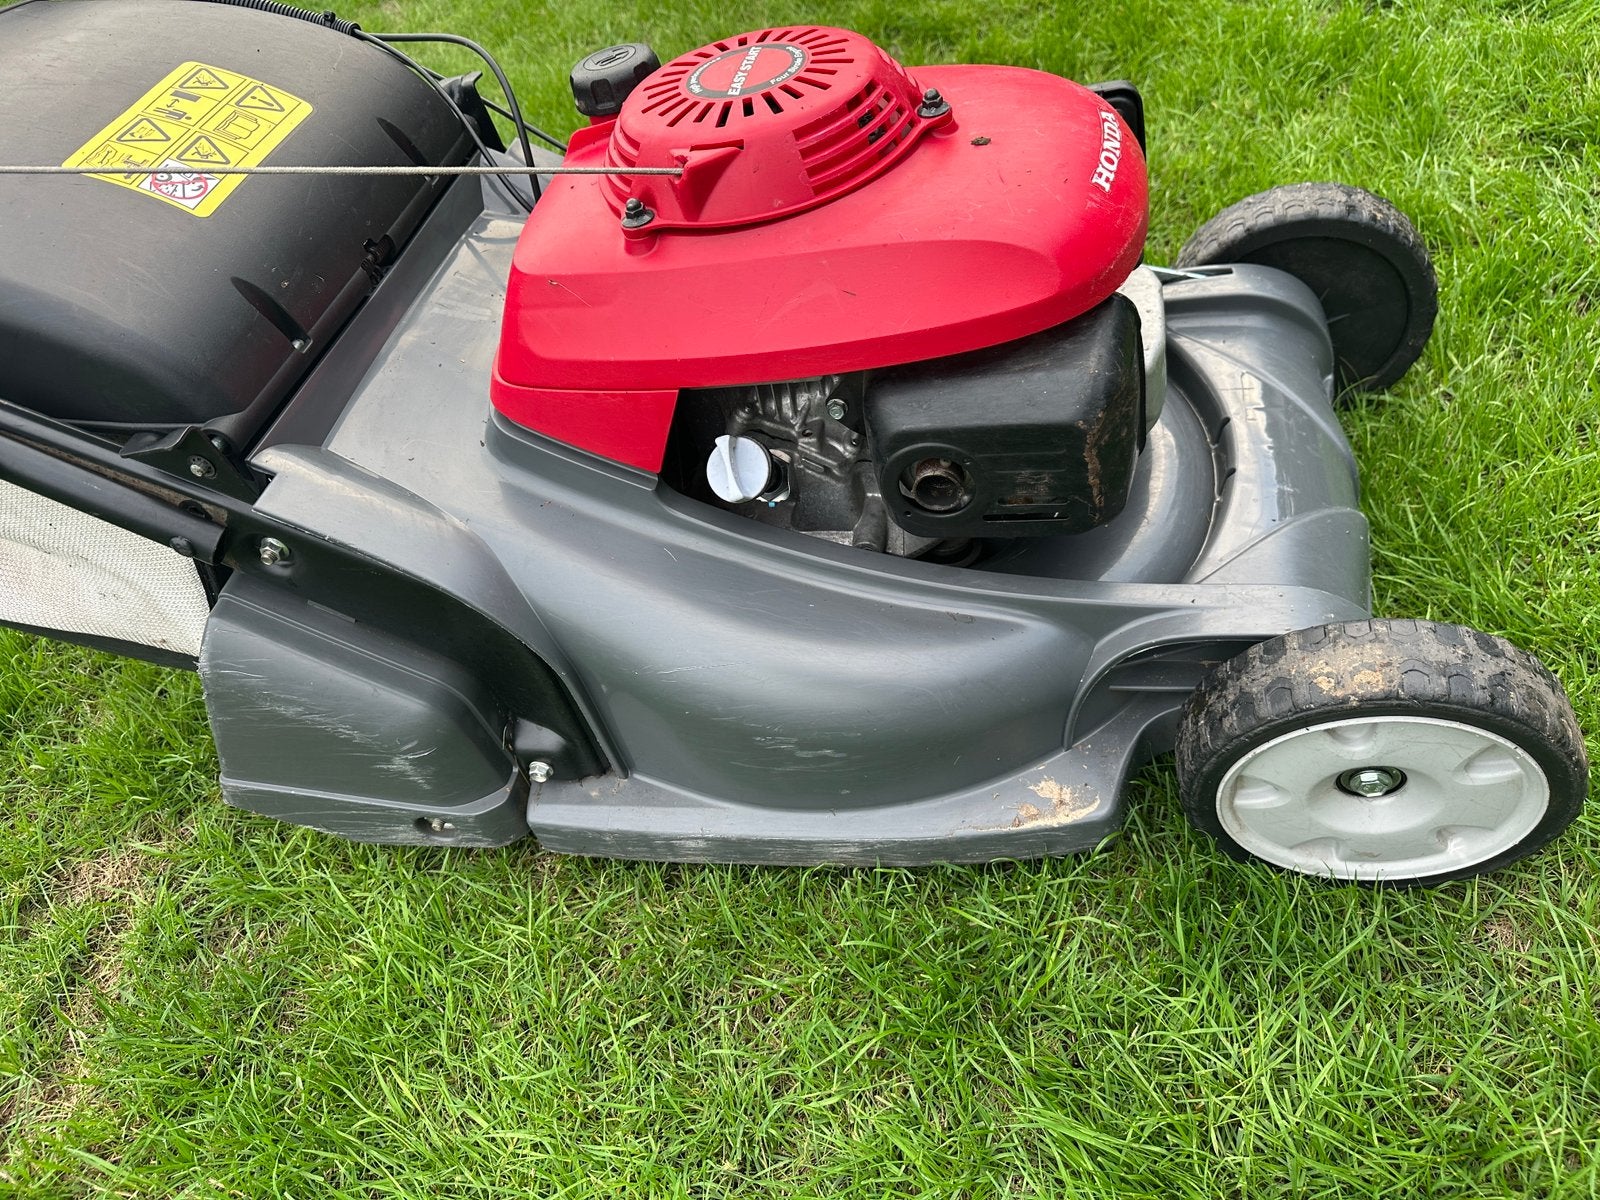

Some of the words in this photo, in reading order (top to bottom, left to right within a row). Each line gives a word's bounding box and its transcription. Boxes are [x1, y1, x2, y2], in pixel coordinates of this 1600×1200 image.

[727, 71, 748, 96] EASY
[739, 46, 762, 71] START
[769, 72, 790, 85] Four
[1091, 111, 1122, 193] HONDA
